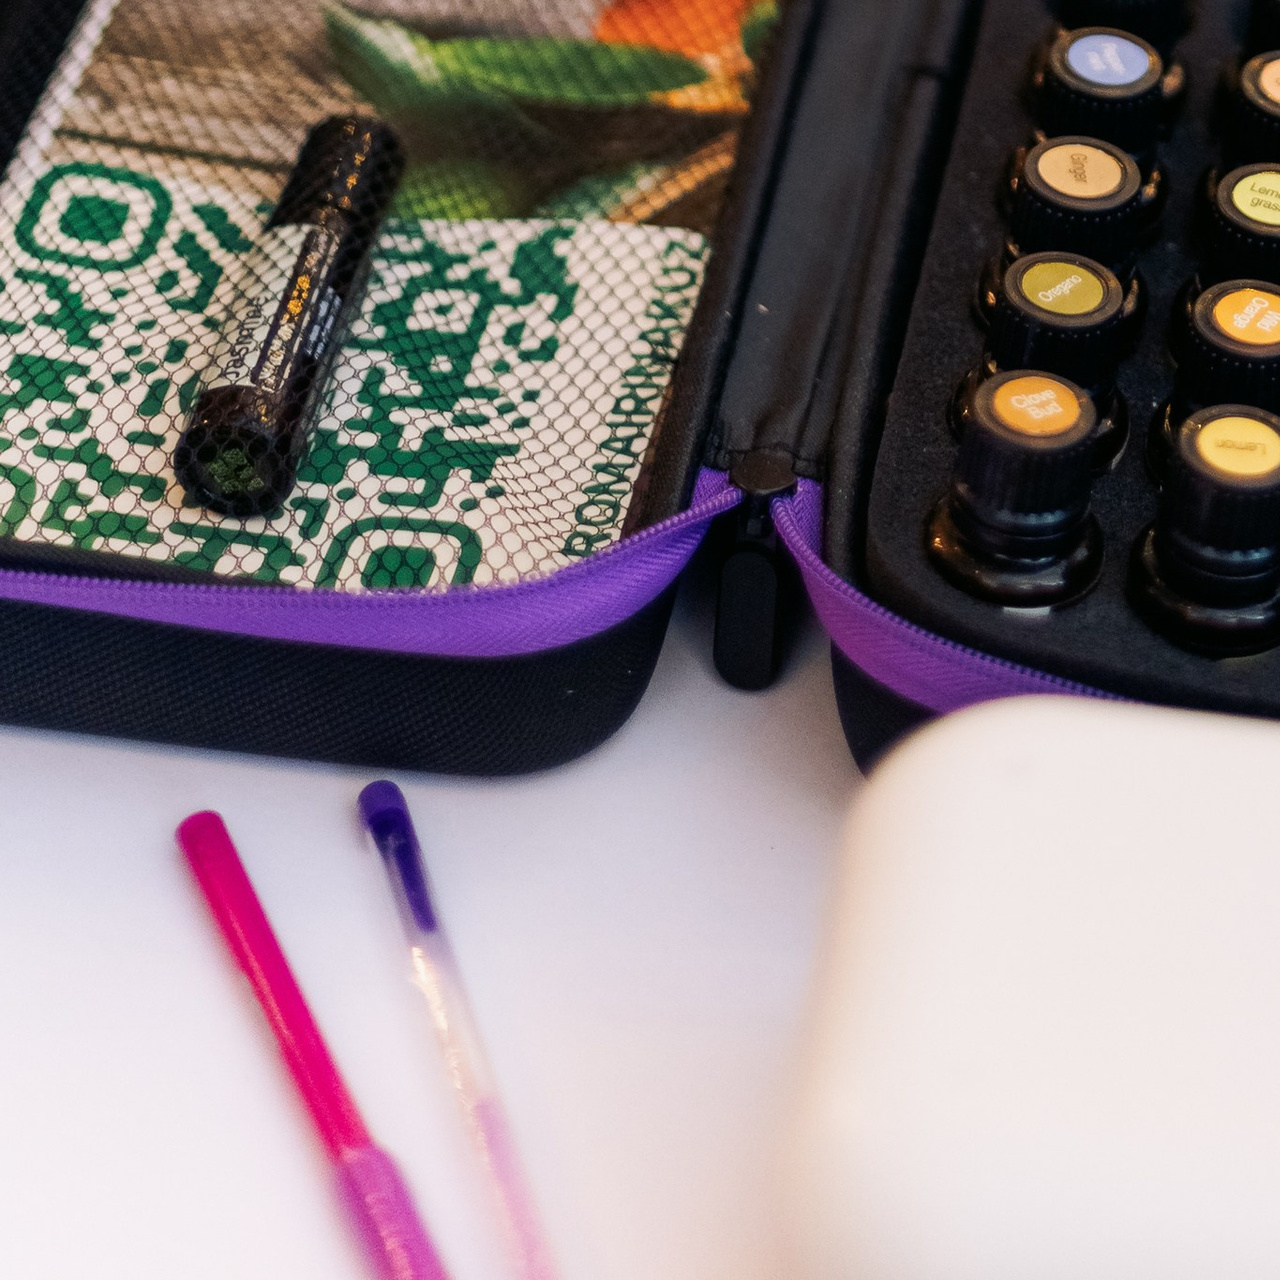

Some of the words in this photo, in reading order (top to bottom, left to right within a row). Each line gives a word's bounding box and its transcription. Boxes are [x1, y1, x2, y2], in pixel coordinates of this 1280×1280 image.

[1068, 152, 1088, 184] Ginger
[1038, 274, 1082, 302] Oregano
[1233, 297, 1269, 329] Orange
[1011, 389, 1057, 409] Clove
[1027, 400, 1063, 419] Bud
[1214, 438, 1267, 455] Lemon
